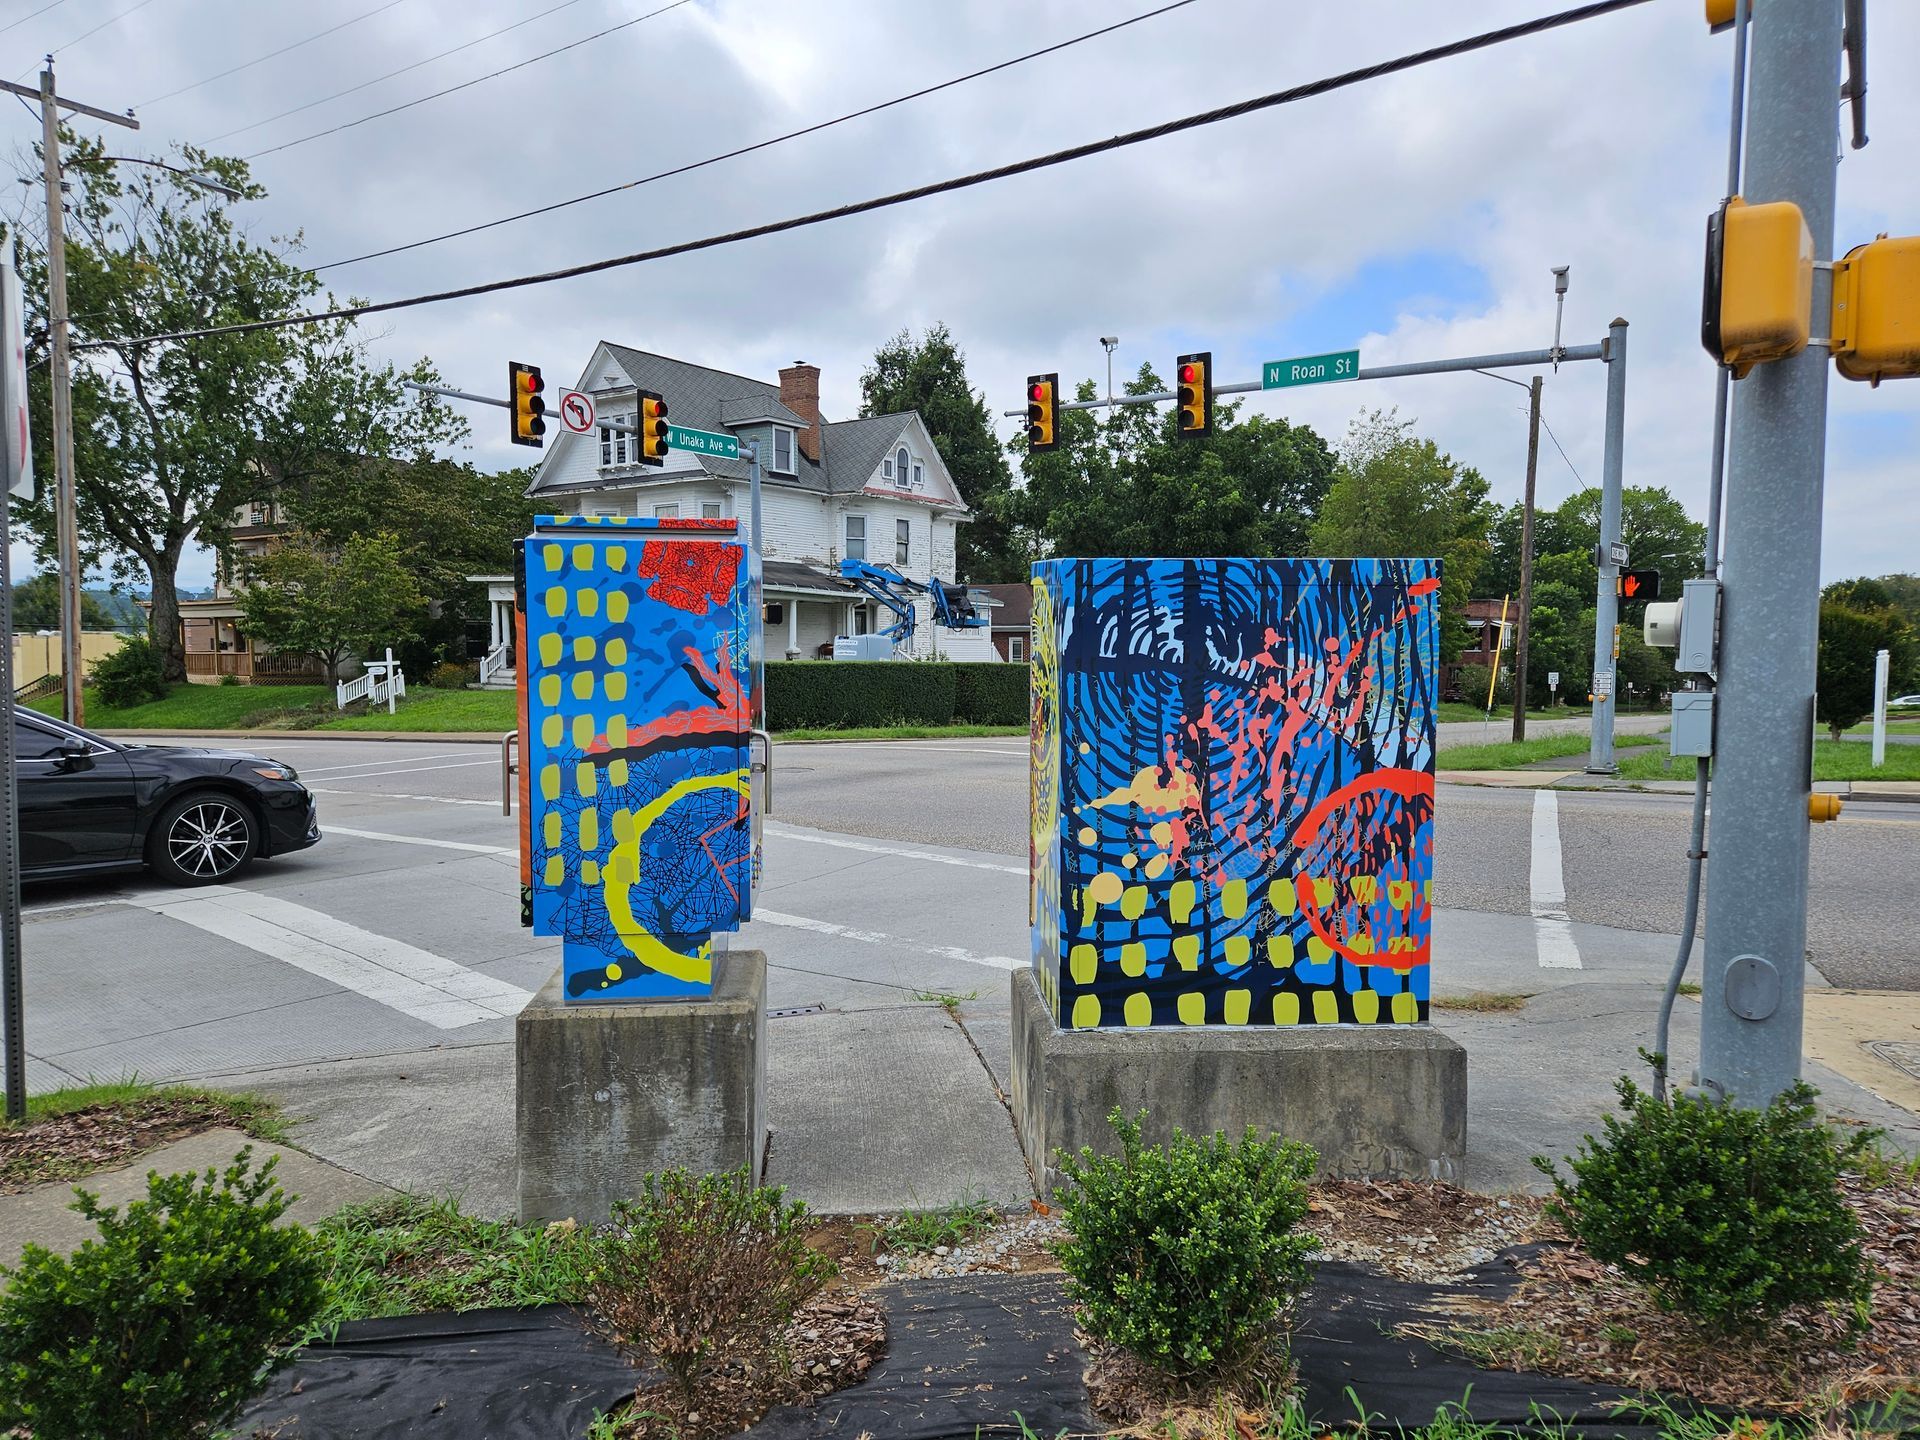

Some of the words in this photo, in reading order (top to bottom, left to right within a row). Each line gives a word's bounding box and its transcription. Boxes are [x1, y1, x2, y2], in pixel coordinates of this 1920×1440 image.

[1270, 367, 1279, 383] N
[1291, 365, 1325, 380] Roan
[1335, 358, 1351, 374] St
[666, 430, 673, 443] W
[680, 432, 705, 449] Unaka
[709, 438, 723, 452] Ave
